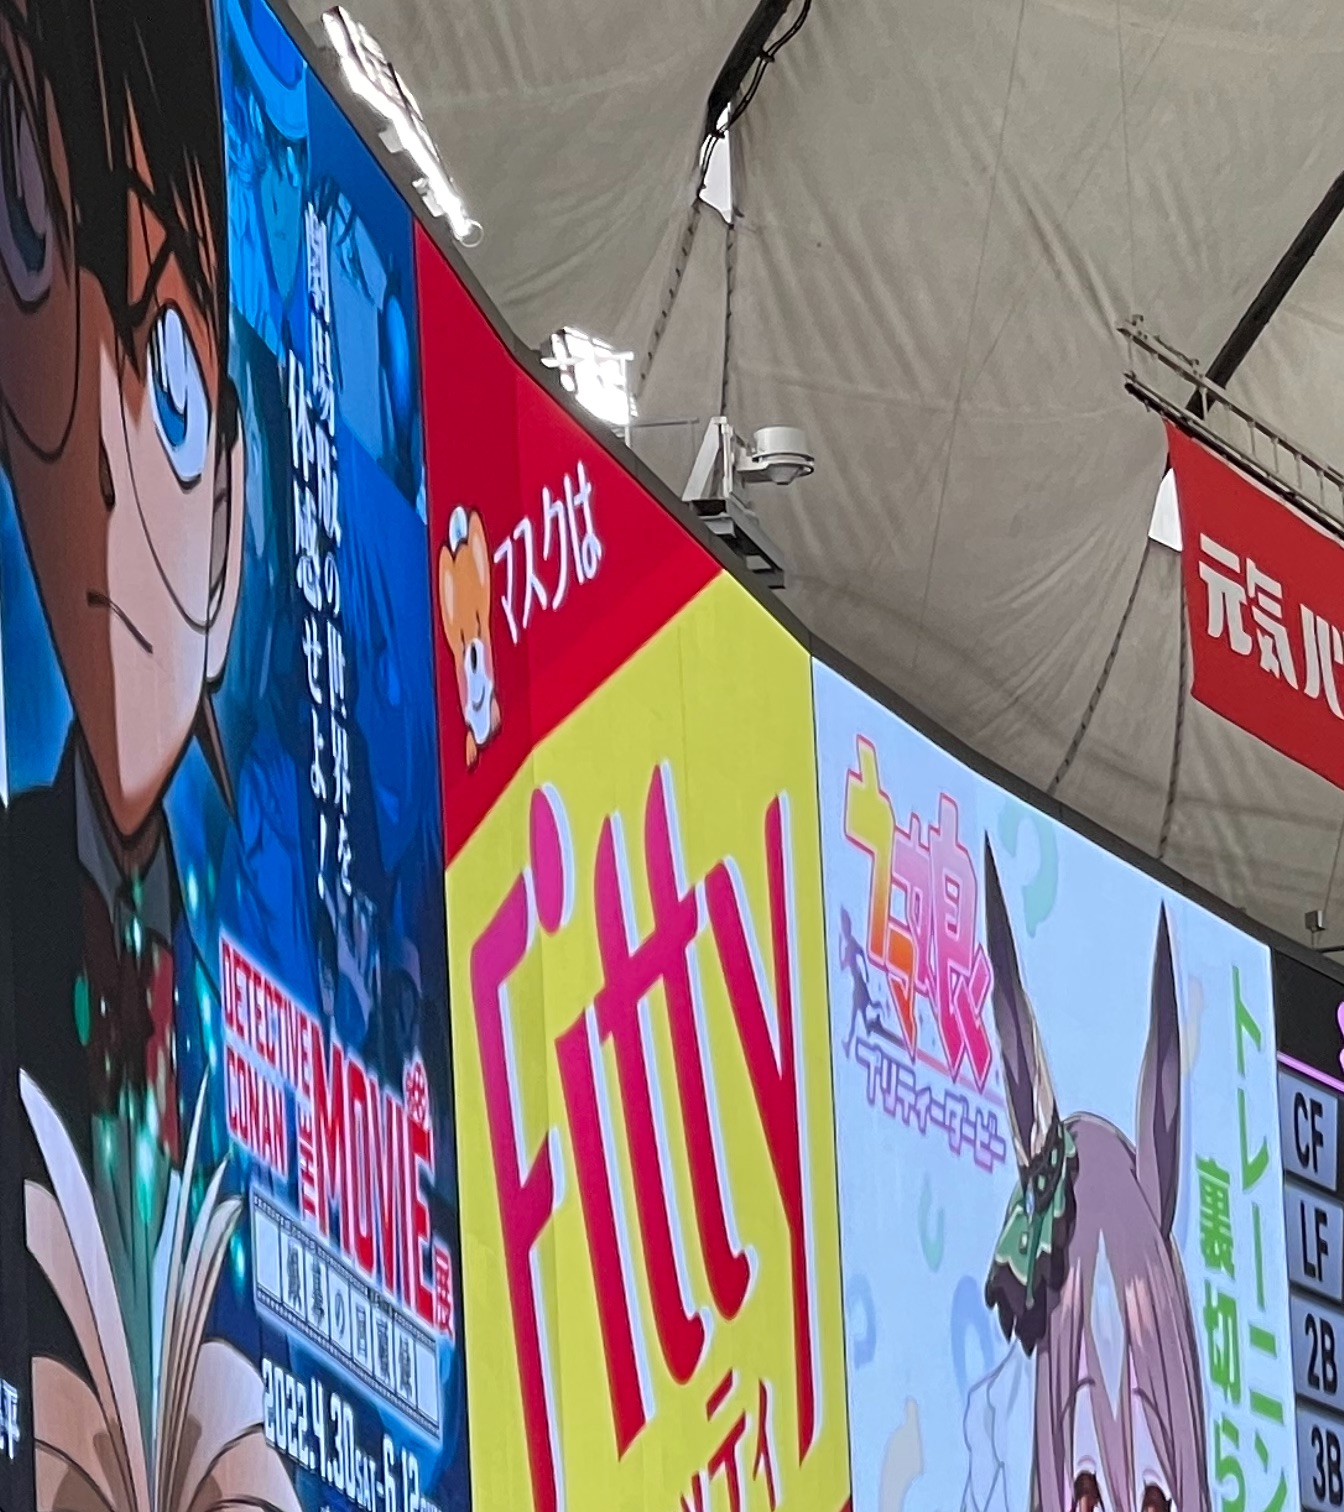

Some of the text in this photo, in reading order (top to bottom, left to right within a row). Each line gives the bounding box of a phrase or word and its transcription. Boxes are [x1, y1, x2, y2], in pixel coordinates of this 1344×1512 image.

[493, 460, 604, 646] マスクは
[221, 934, 310, 1099] DETECTIVE
[225, 1048, 288, 1182] CONAN
[1293, 1091, 1324, 1174] CF
[312, 1021, 436, 1324] MOVIE
[1300, 1201, 1328, 1282] LF
[1304, 1313, 1339, 1396] 2B
[1310, 1425, 1344, 1508] 3B
